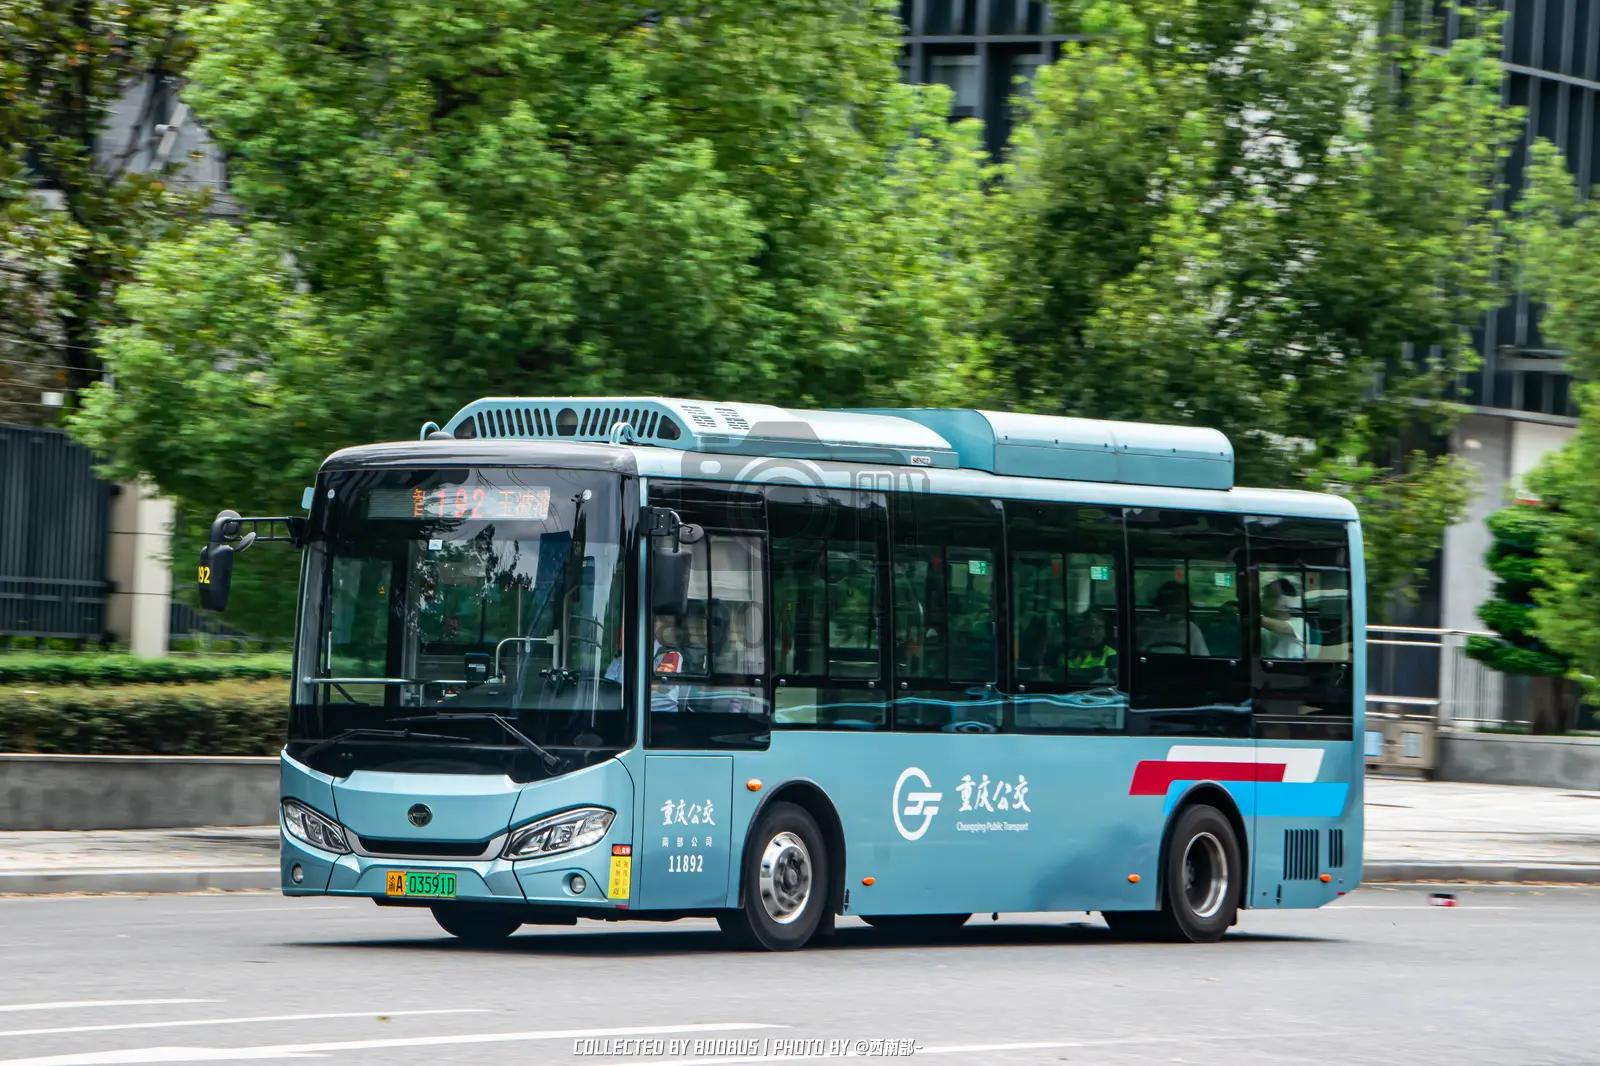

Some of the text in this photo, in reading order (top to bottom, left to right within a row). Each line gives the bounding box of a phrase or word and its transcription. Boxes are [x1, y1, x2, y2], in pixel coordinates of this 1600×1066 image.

[437, 488, 485, 518] 192
[956, 774, 1032, 813] 重庆公交
[660, 799, 716, 826] 重庆公交
[956, 821, 1029, 833] Chongqing Public Transport
[661, 836, 713, 848] 南部公司
[668, 854, 703, 873] 11892
